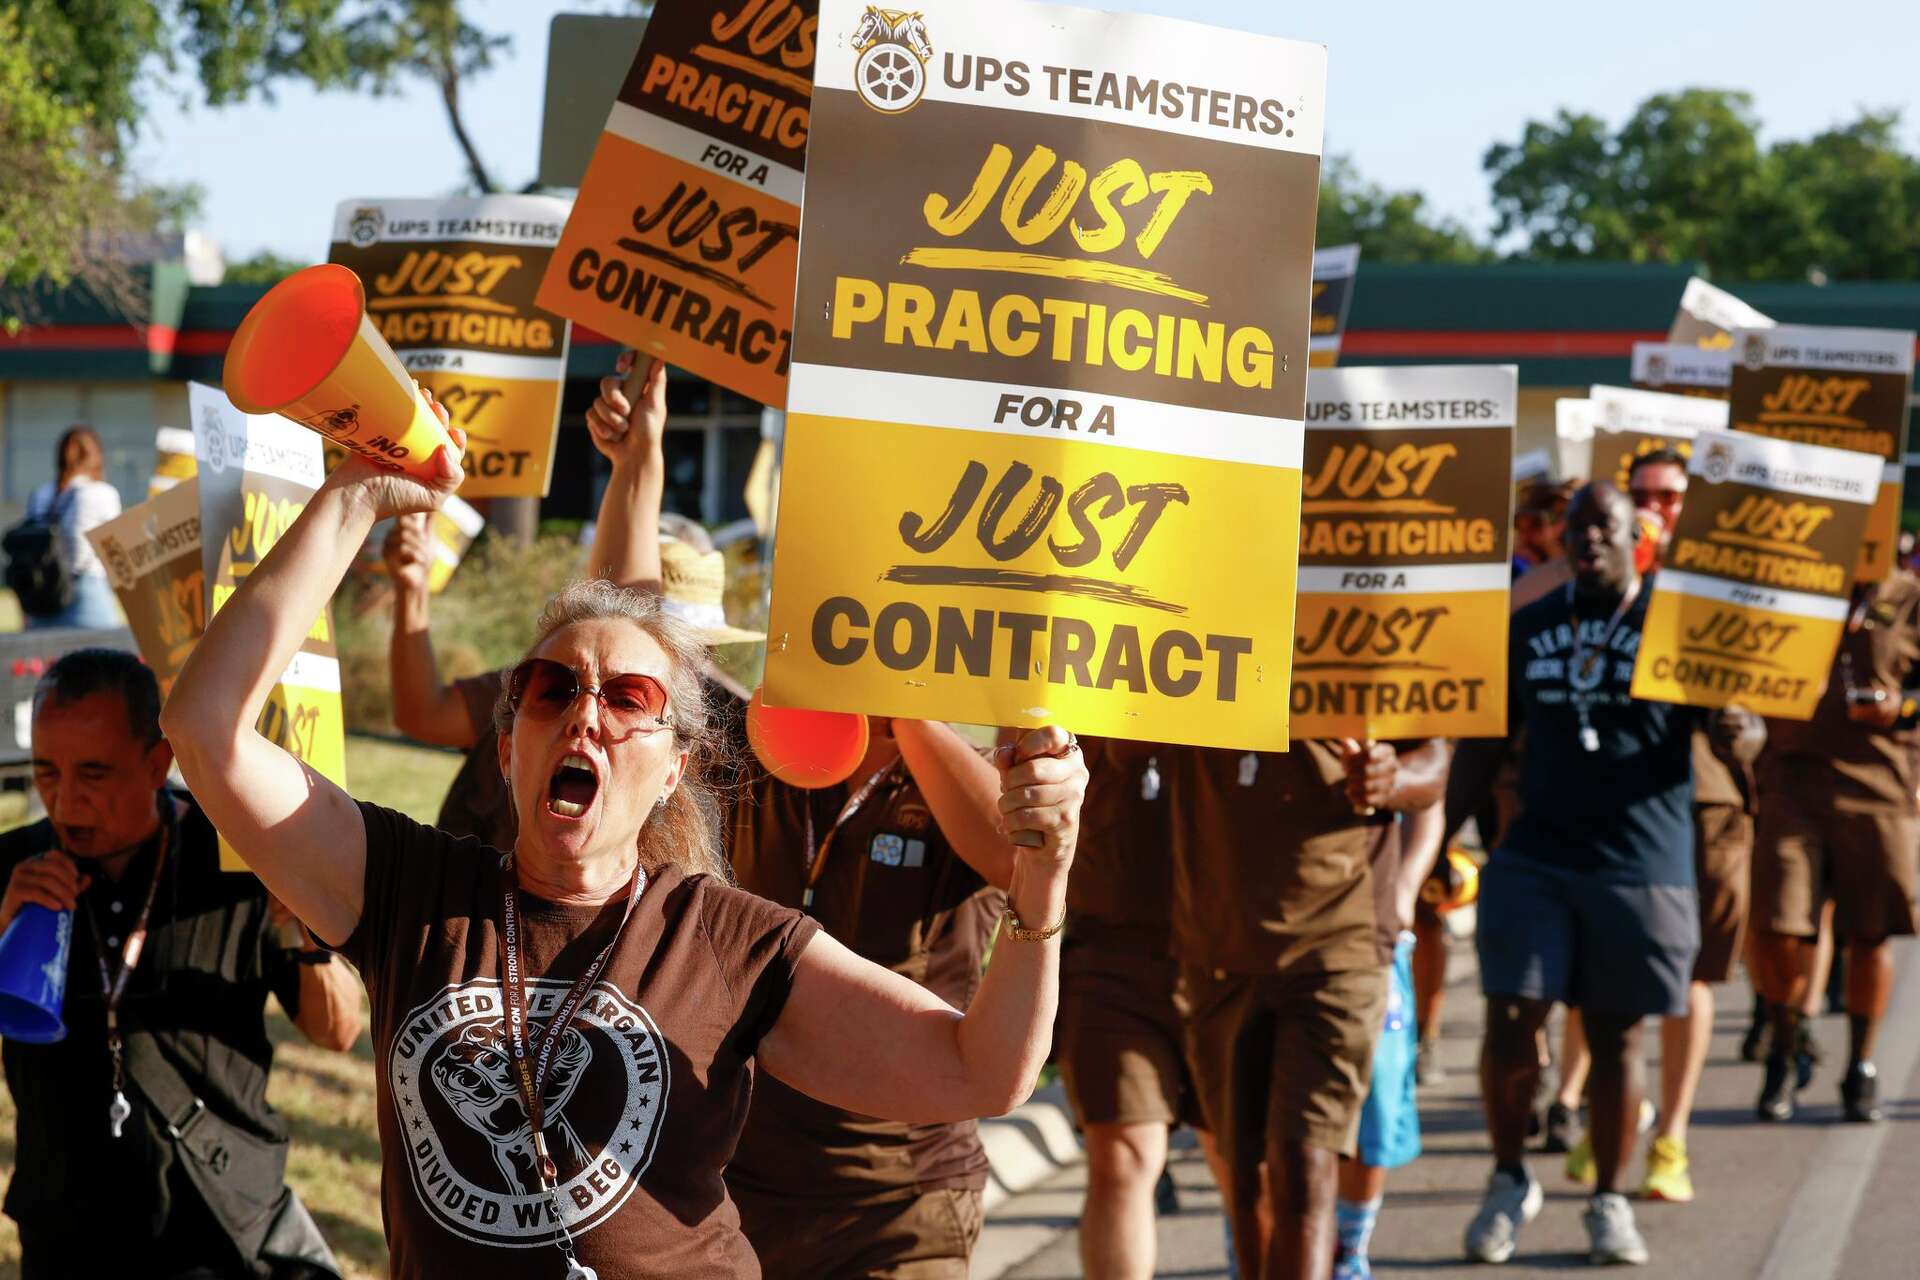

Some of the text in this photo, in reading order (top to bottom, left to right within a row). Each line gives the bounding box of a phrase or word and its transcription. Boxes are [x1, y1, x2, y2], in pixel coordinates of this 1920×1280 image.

[711, 0, 817, 68] JUS
[641, 54, 810, 150] PRACTIC
[943, 51, 1296, 139] UPS TEAMSTERS:
[700, 144, 769, 186] FOR A
[923, 143, 1213, 259] JUST
[389, 220, 430, 235] UPS
[632, 181, 800, 273] JUST
[375, 250, 522, 296] JUST
[367, 312, 551, 348] ACTICING
[567, 247, 791, 376] CONTRACT
[831, 276, 1275, 389] PRACTICING
[405, 355, 463, 367] FOR A
[993, 393, 1116, 436] FOR A
[1306, 400, 1499, 421] UPS TEAMSTERS:
[1762, 374, 1872, 415] JUST
[1302, 444, 1457, 498] JUST
[898, 460, 1190, 572] JUST
[1300, 518, 1494, 555] ACTICING
[1716, 495, 1834, 543] JUST
[1342, 573, 1406, 588] FOR A
[1674, 539, 1844, 593] PRACTICING
[811, 596, 1253, 702] CONTRACT
[1295, 605, 1449, 656] JUST
[1687, 609, 1800, 655] JUST
[1290, 679, 1484, 715] ONTRACT
[1652, 656, 1809, 701] CONTRACT
[505, 890, 516, 944] CONTRACT!
[507, 945, 519, 983] STRONG
[585, 962, 599, 977] ON
[510, 991, 519, 1006] FOR
[511, 1007, 521, 1024] ON
[549, 999, 576, 1035] STRONG
[400, 995, 484, 1060] UNITED
[579, 993, 660, 1084] ARGAIN
[513, 1025, 525, 1059] GAME
[518, 1060, 538, 1114] amsters:
[535, 1036, 555, 1092] CONTRAC
[415, 1138, 501, 1226] DIVIDED
[568, 1157, 622, 1212] BEG
